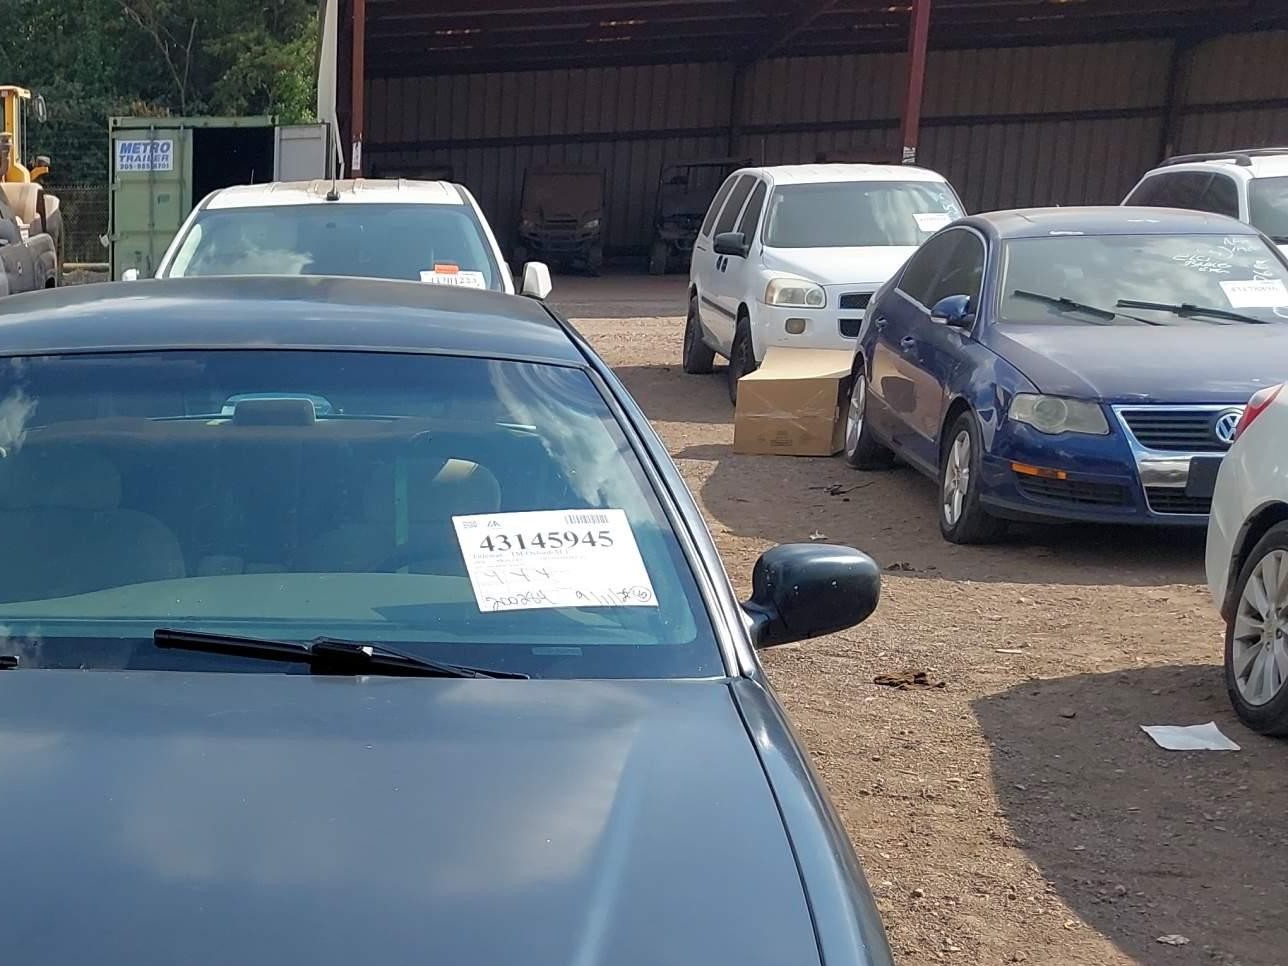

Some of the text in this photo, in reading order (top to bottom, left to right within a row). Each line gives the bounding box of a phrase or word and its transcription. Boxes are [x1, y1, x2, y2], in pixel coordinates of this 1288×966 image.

[120, 142, 171, 154] METRO
[119, 154, 169, 162] TRAILER
[480, 530, 614, 552] 43145945
